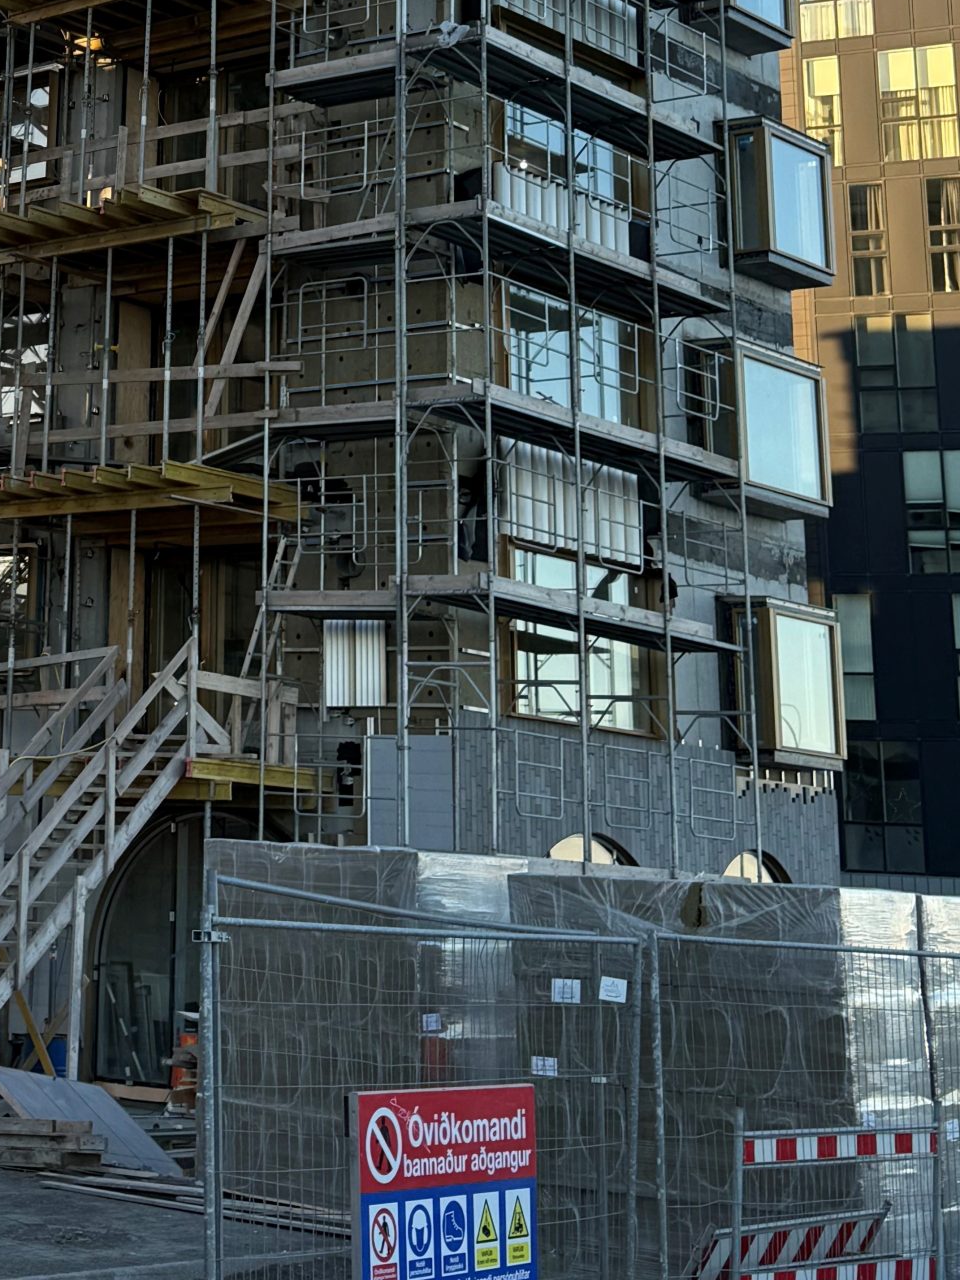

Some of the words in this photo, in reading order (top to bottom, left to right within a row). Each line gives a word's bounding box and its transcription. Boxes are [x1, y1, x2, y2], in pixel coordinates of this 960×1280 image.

[408, 1106, 527, 1147] Óviðkomandi
[403, 1149, 468, 1177] bannaður
[471, 1147, 531, 1174] aðgangur
